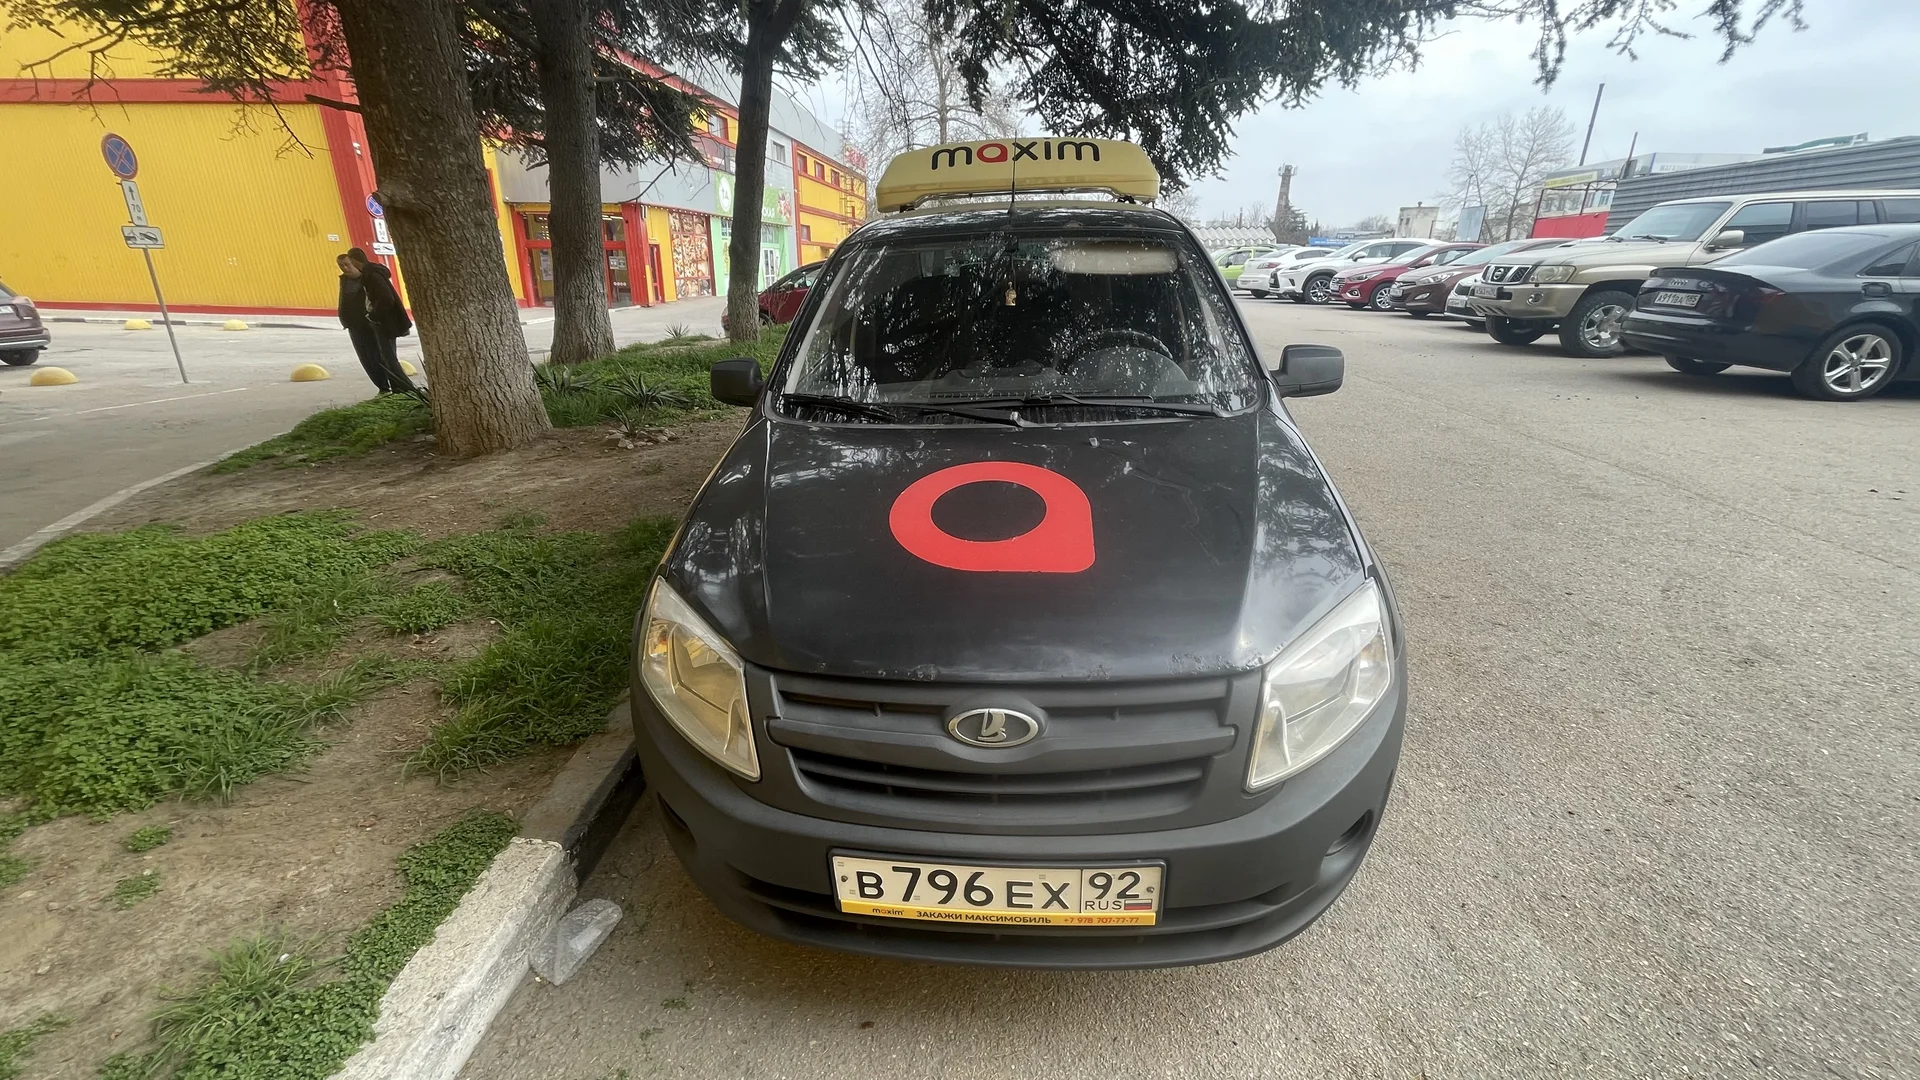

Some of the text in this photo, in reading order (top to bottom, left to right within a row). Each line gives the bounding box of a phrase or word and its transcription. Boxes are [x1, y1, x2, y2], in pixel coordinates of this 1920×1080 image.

[931, 137, 1100, 170] maxim
[130, 203, 141, 213] 70
[1088, 871, 1141, 899] 92
[1085, 900, 1122, 910] RUS
[872, 907, 903, 916] maxim
[916, 910, 1051, 924] ЗАКАЖИ МАКСИМОБИЛЬ
